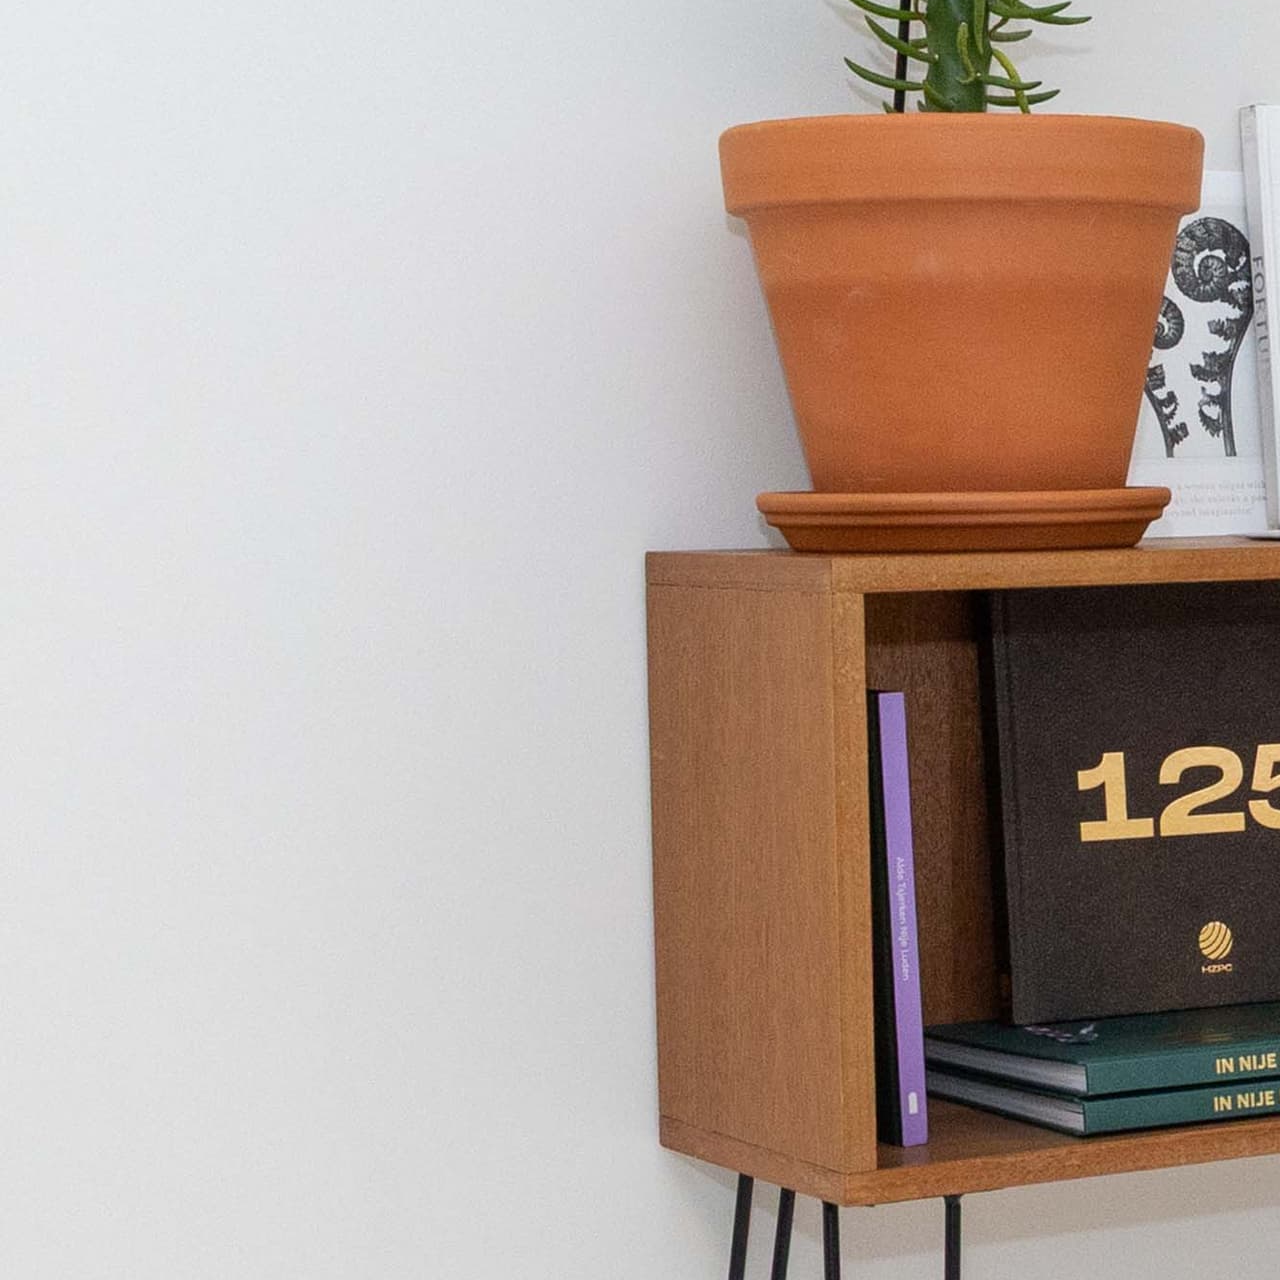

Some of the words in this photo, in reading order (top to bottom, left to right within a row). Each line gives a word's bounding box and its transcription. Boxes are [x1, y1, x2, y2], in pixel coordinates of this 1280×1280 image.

[1201, 963, 1233, 974] HZPC
[1215, 1056, 1234, 1074] IN
[1238, 1051, 1277, 1072] NIJE
[1213, 1094, 1232, 1112] IN
[1236, 1090, 1275, 1110] NIJE
